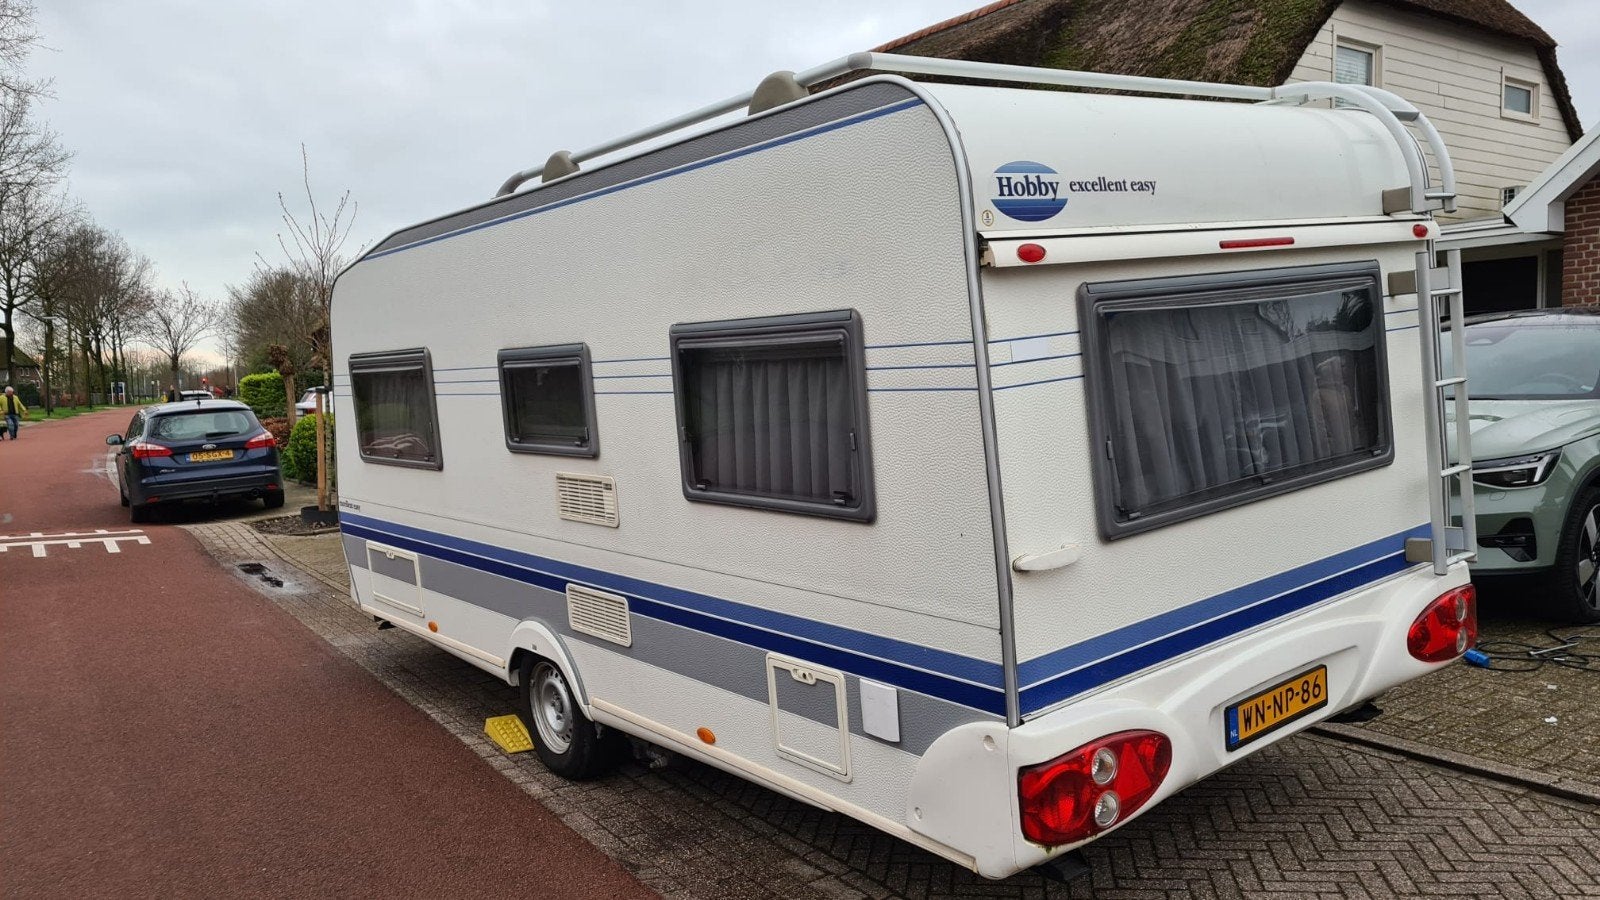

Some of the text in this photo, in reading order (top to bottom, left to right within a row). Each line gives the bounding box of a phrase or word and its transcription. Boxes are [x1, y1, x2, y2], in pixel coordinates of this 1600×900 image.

[996, 175, 1157, 201] Hobby excellent easy
[1242, 674, 1322, 733] WN-NP-86
